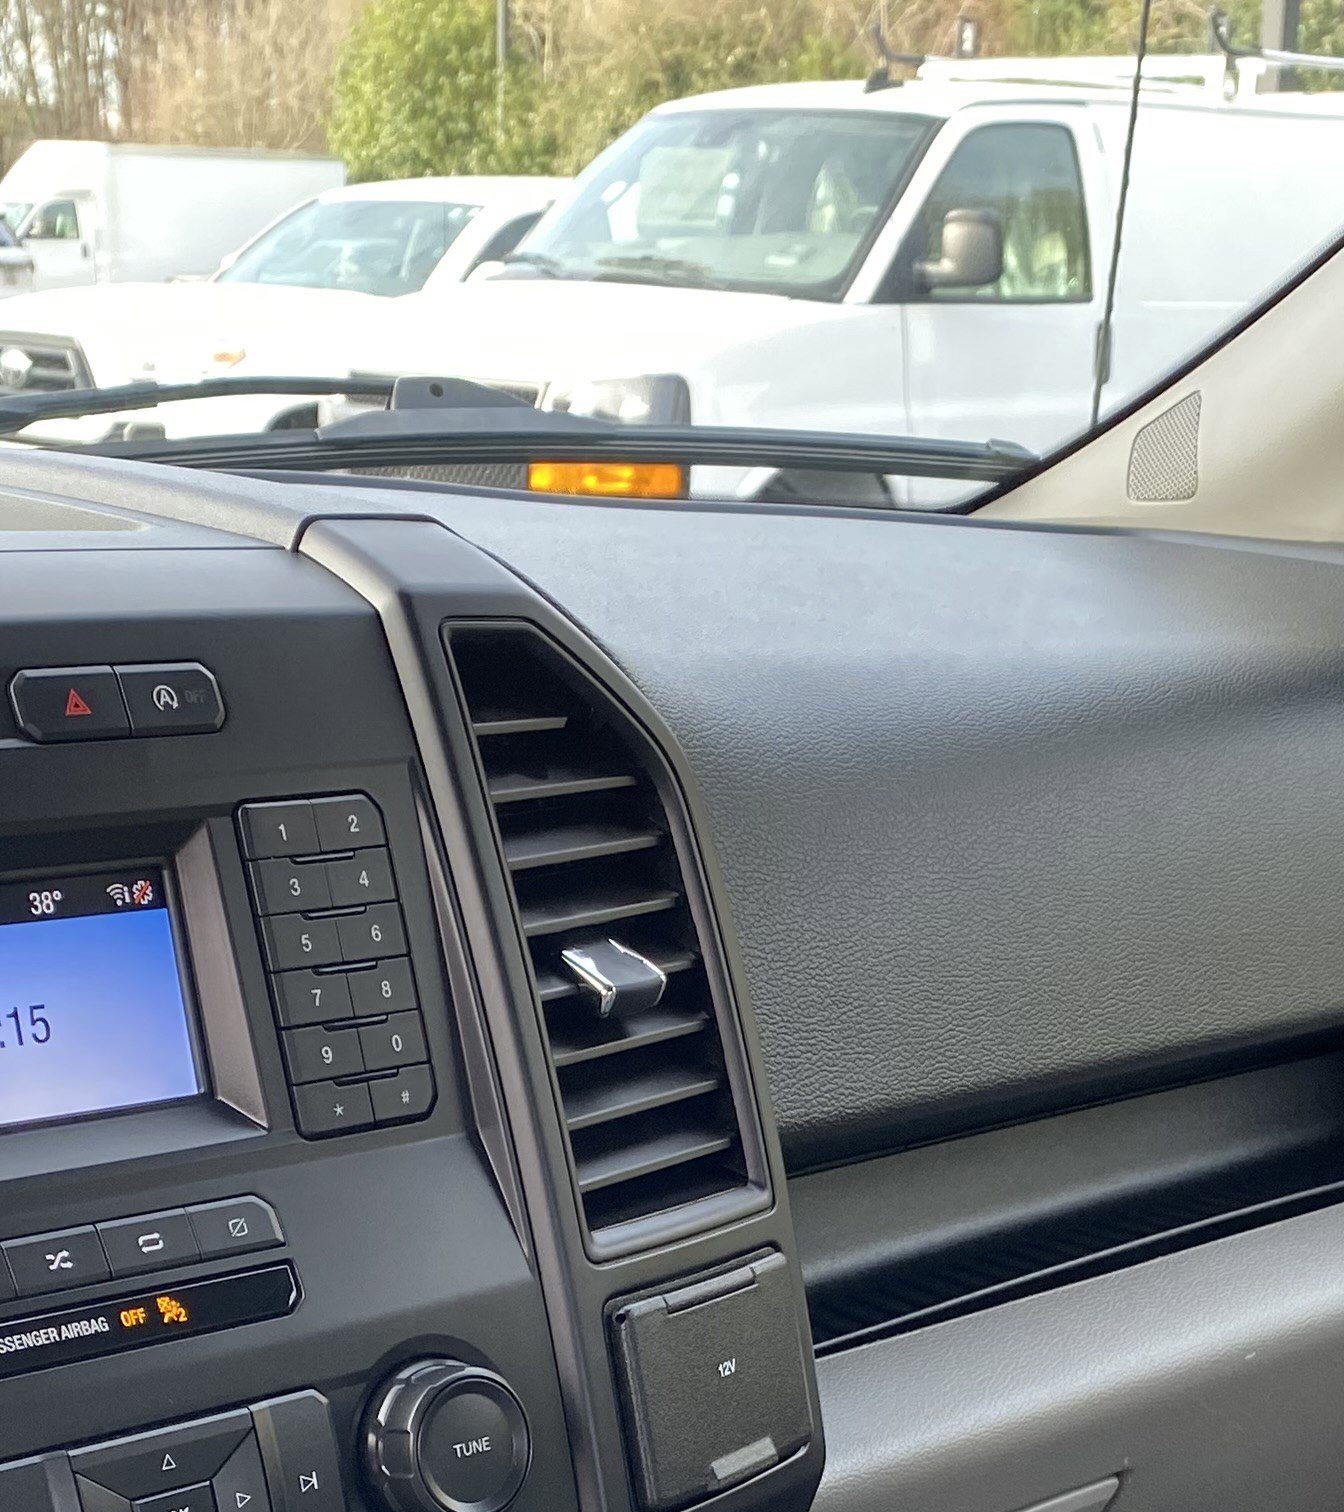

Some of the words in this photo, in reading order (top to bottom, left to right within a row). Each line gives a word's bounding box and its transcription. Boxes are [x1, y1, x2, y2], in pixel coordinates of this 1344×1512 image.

[278, 824, 287, 841] 1
[348, 815, 359, 832] 2
[289, 878, 301, 896] 3
[359, 870, 370, 888] 4
[371, 924, 382, 942] 6
[301, 934, 312, 952] 5
[311, 989, 322, 1006] 7
[381, 980, 392, 998] 8
[391, 1034, 403, 1052] 0
[321, 1046, 333, 1064] 9
[60, 1316, 110, 1342] AIRBAG
[120, 1307, 146, 1328] OFF
[718, 1358, 736, 1378] 12V
[453, 1436, 492, 1458] TUNE
